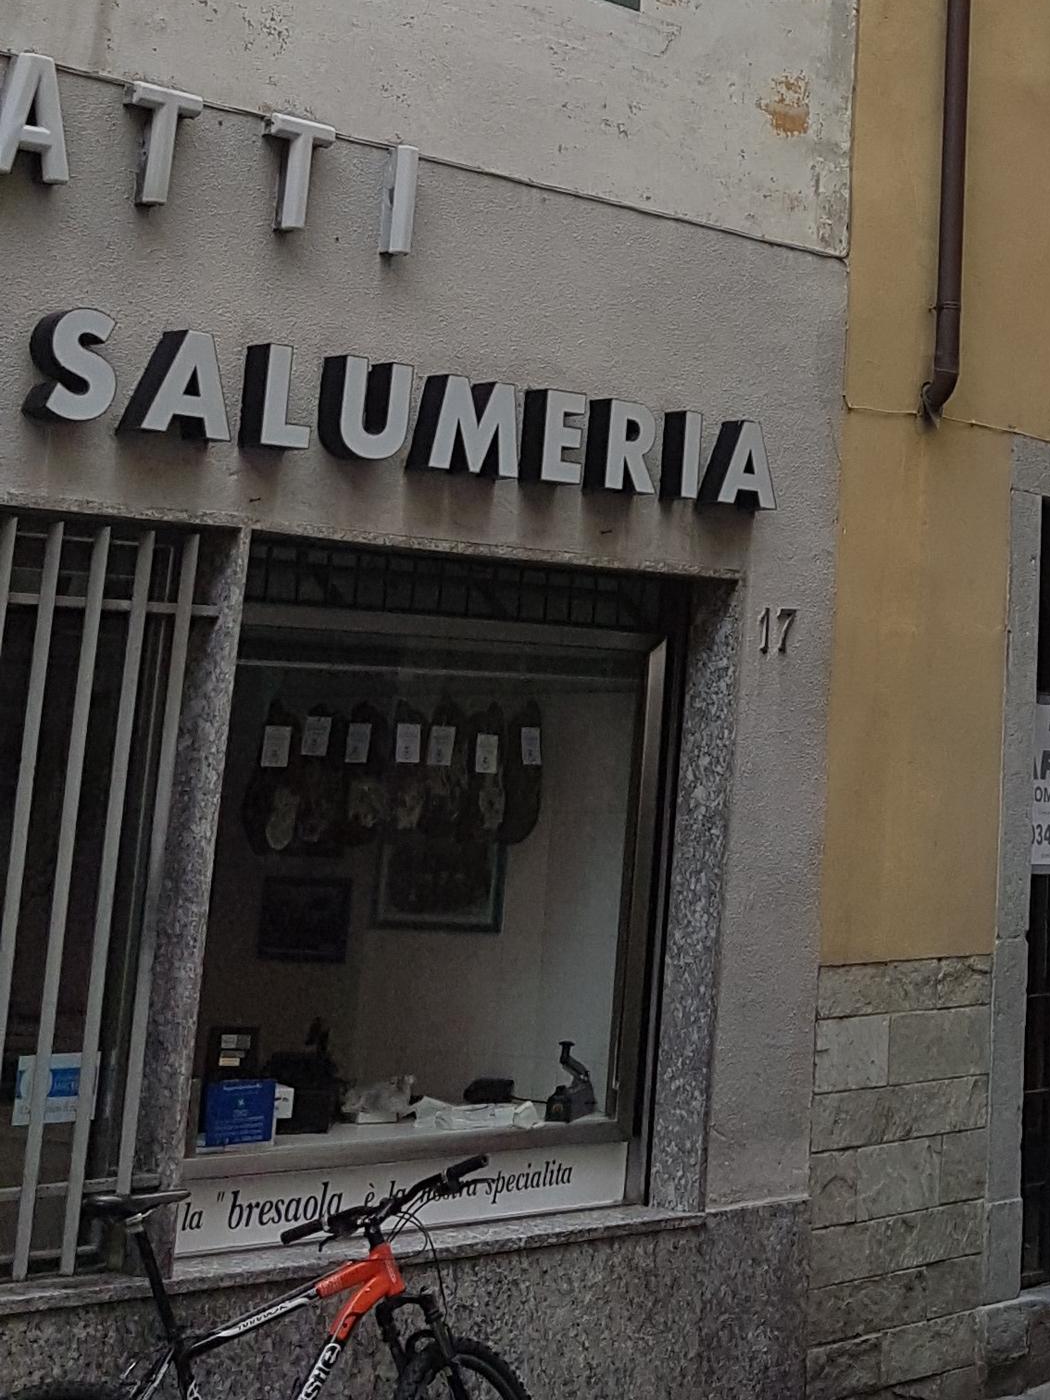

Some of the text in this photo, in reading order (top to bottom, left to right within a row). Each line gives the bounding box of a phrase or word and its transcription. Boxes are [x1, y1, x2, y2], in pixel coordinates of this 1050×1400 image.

[0, 51, 420, 256] ATTI
[20, 306, 778, 511] SALUMERIA
[758, 606, 800, 655] 17
[181, 1202, 203, 1231] la
[485, 1159, 573, 1204] specialita
